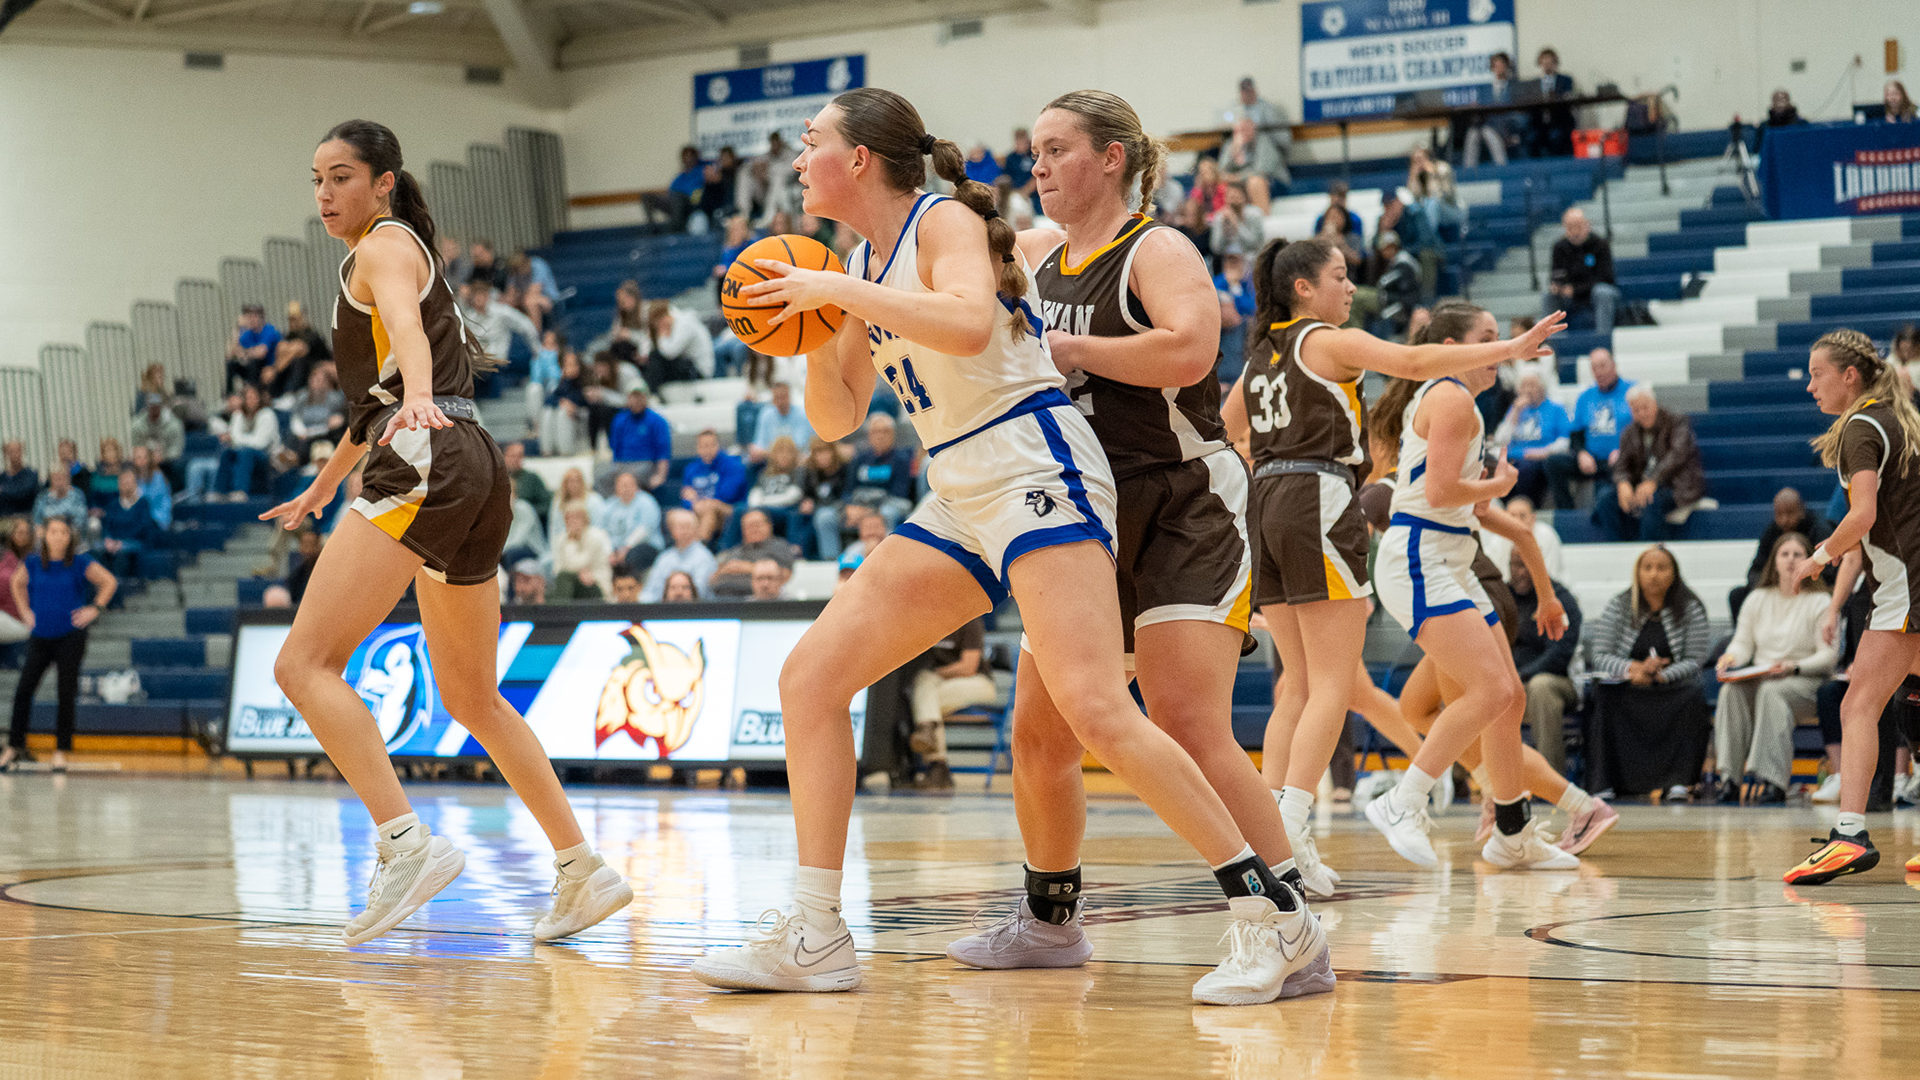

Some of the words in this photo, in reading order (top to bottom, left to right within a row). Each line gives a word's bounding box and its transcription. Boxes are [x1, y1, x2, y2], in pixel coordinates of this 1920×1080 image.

[1042, 299, 1095, 335] WAN
[883, 354, 935, 416] 24
[1250, 371, 1292, 434] 33
